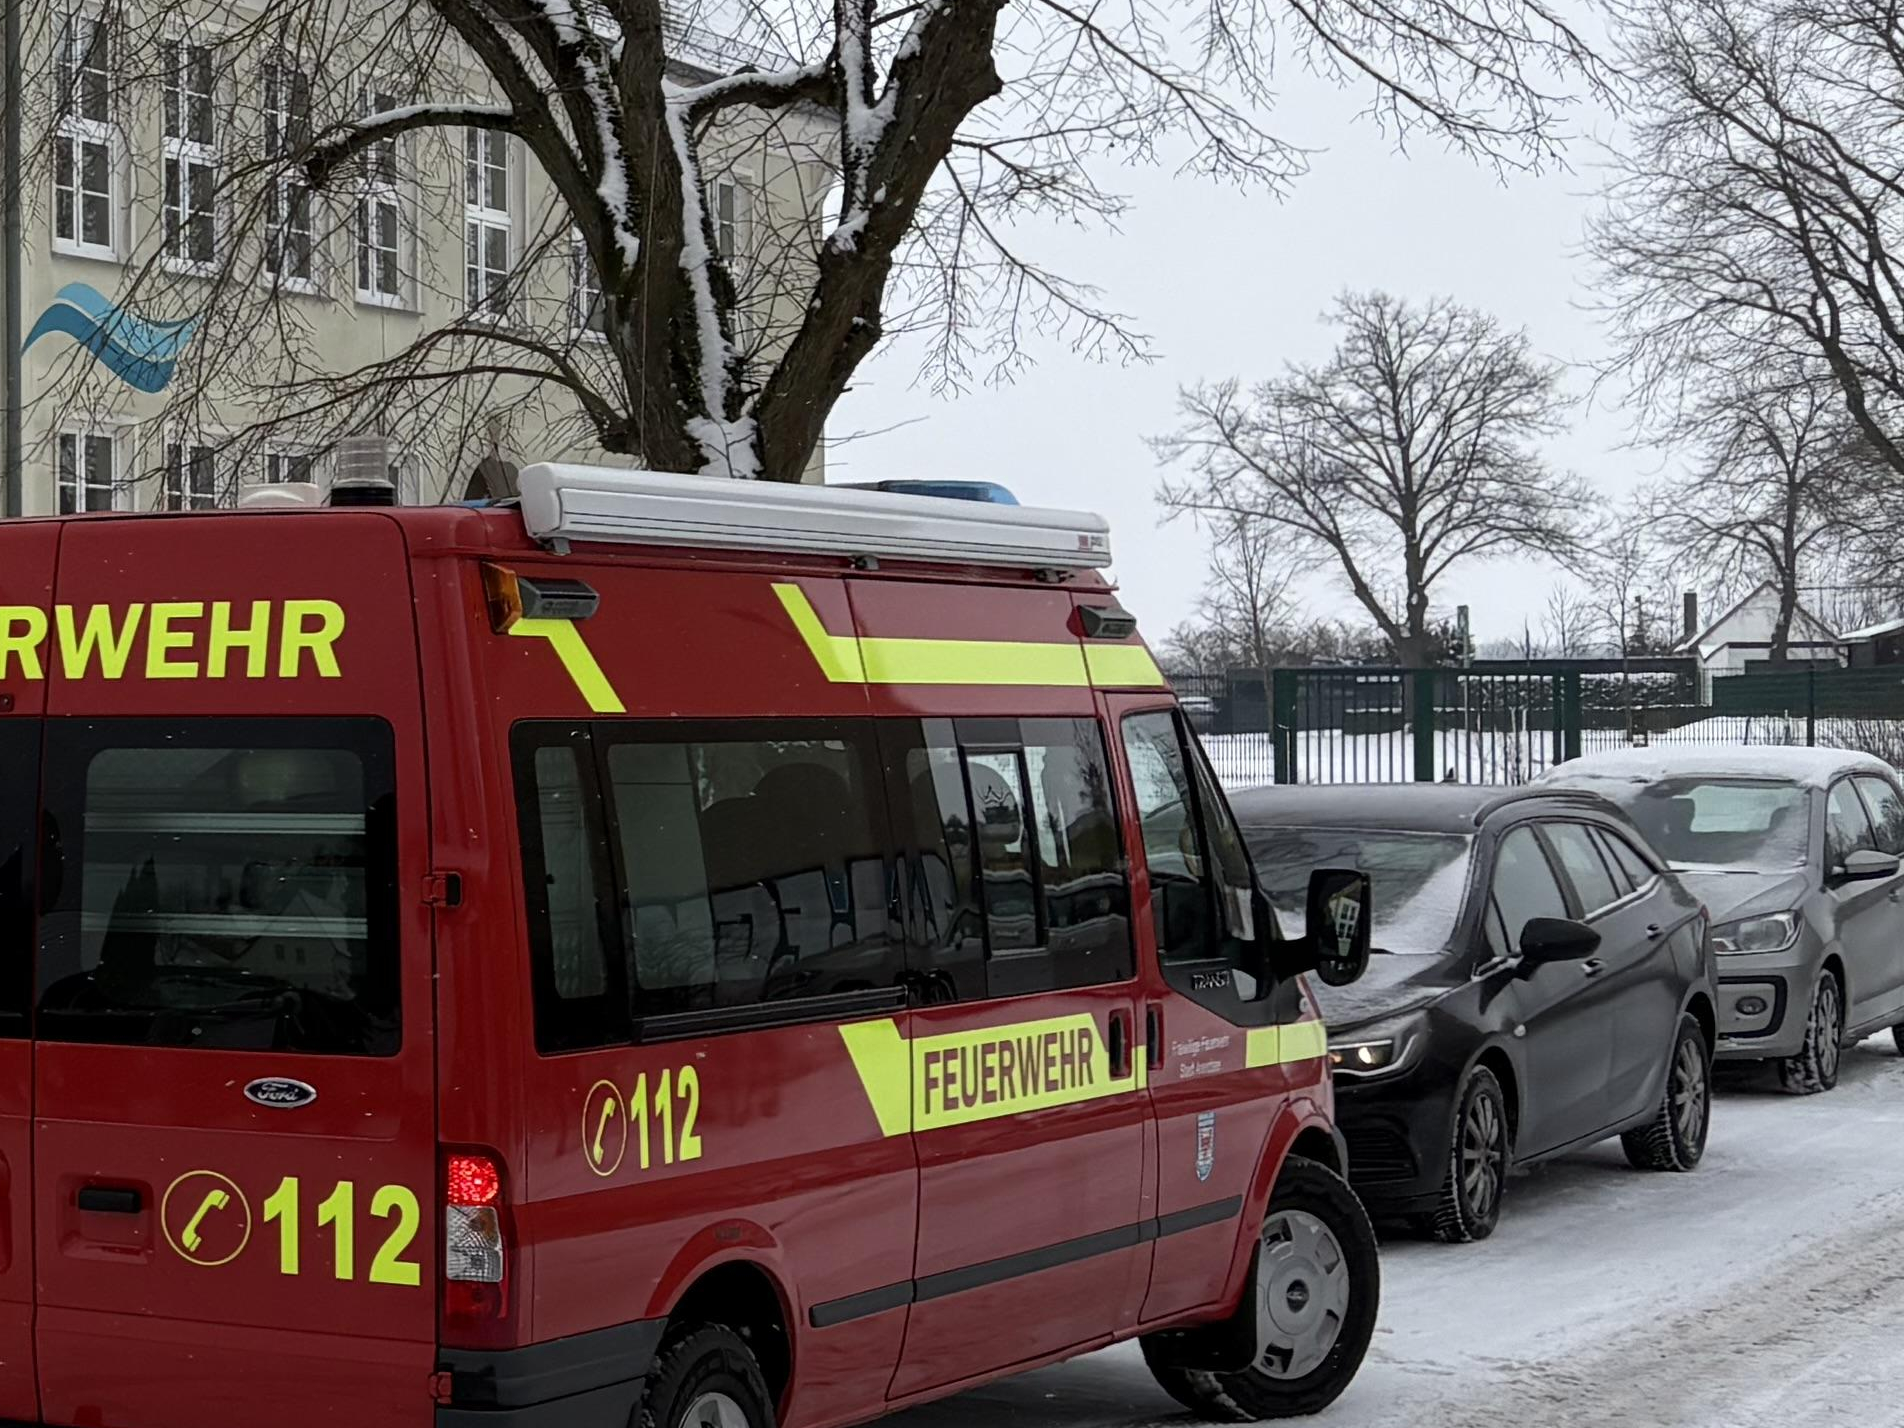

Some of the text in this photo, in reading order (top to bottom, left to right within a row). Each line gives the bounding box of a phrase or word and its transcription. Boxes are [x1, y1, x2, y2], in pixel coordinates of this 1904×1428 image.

[630, 1065, 702, 1169] 112
[923, 1027, 1094, 1115] FEUERWEHR
[262, 1176, 421, 1286] 112
